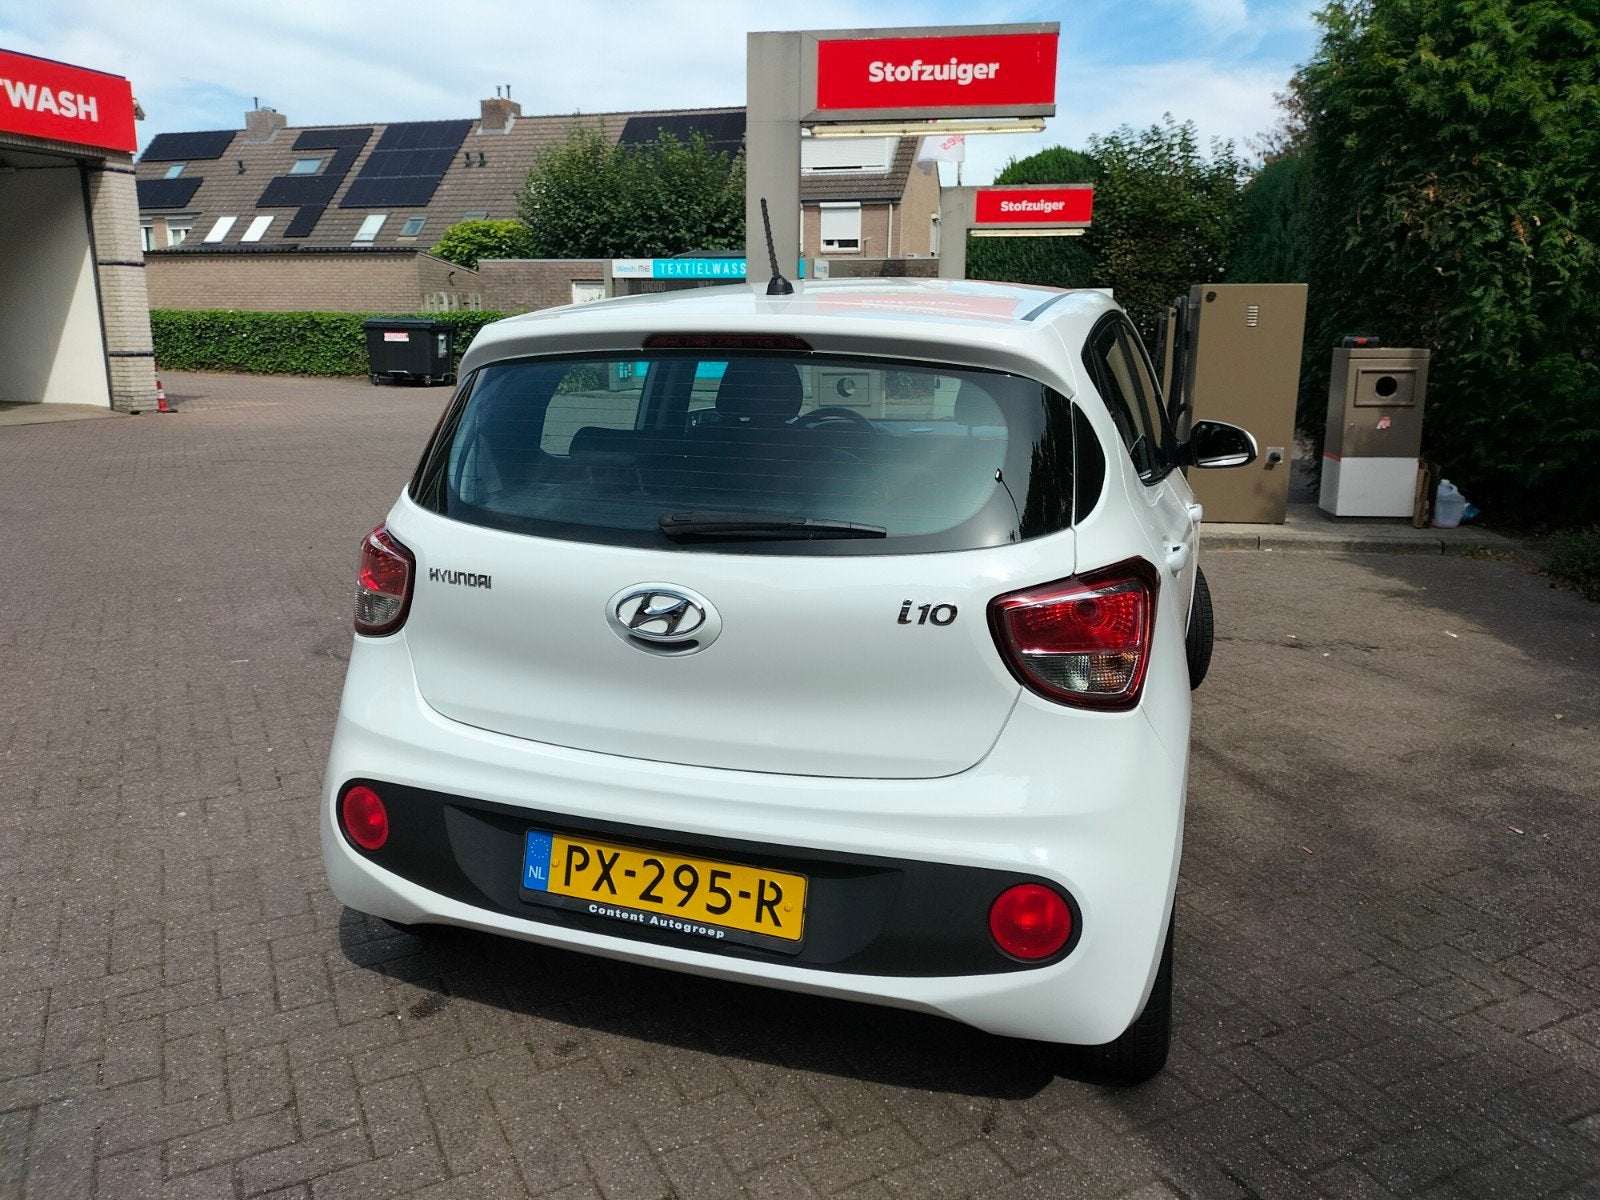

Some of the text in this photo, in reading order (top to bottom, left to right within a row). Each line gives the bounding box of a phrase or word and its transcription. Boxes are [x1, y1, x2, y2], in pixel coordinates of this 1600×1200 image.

[868, 57, 1000, 86] Stofzuiger
[1000, 199, 1065, 214] Stofzuiger
[429, 567, 492, 590] HYUNDAI
[897, 599, 958, 626] i10
[528, 844, 783, 927] NL PX-295-R
[588, 903, 725, 939] Content Autogroep
